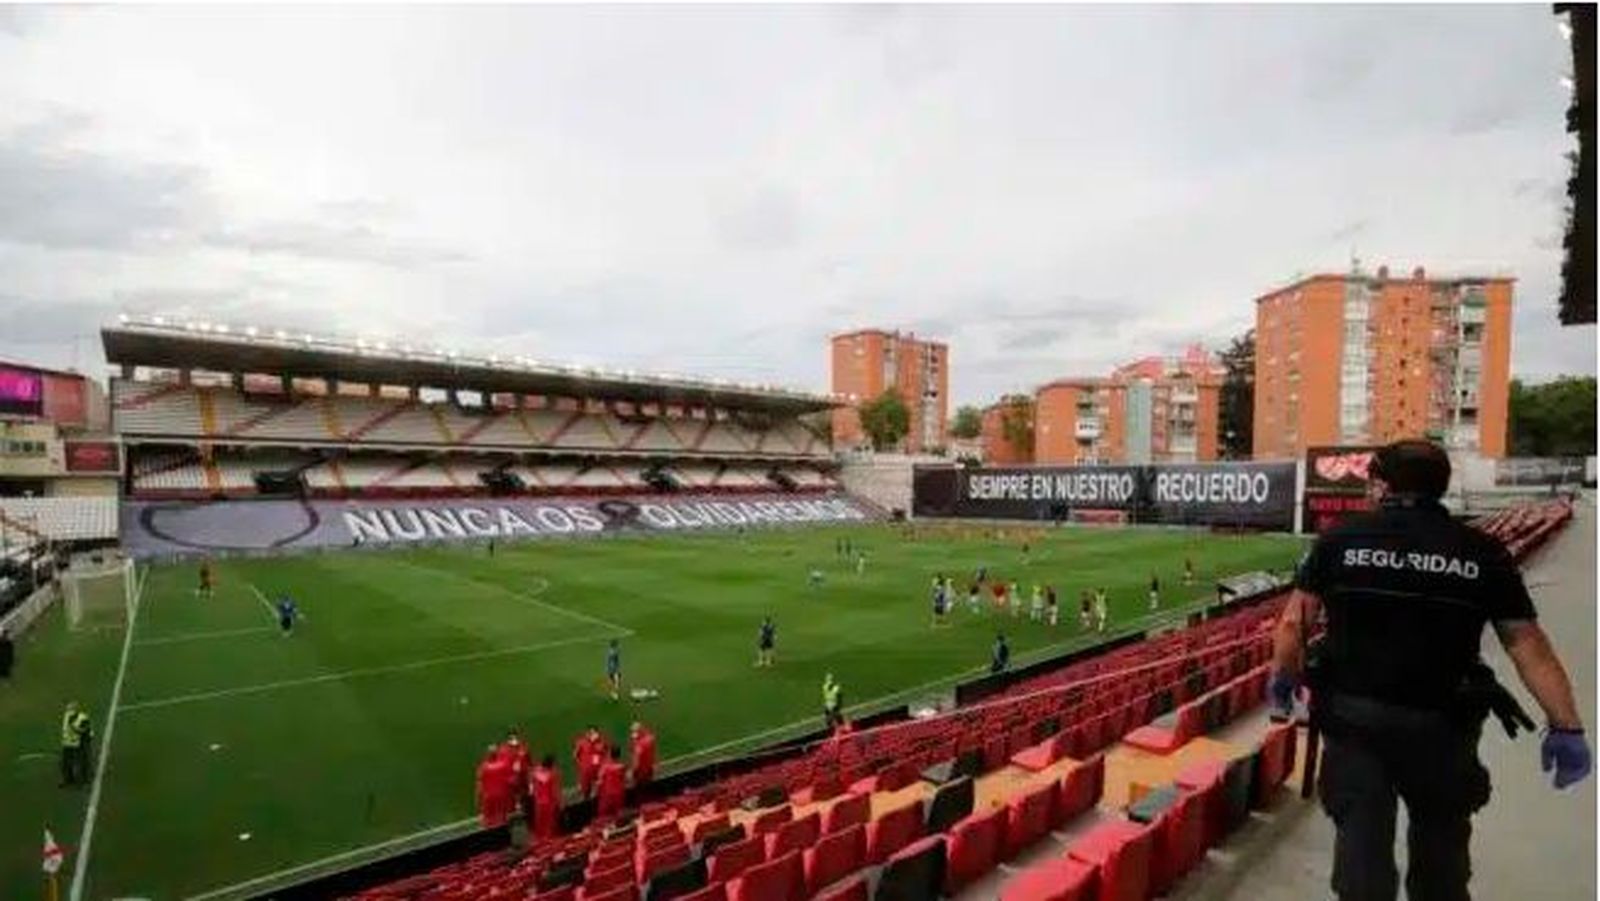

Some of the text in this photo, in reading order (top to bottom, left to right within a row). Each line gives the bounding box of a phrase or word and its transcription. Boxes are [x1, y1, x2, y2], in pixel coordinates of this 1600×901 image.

[968, 473, 1270, 502] SIEMPRE EN NUESTRO RECUERDO
[343, 507, 539, 542] NUNCA
[537, 506, 605, 532] OS
[1343, 549, 1480, 579] SEGURIDAD
